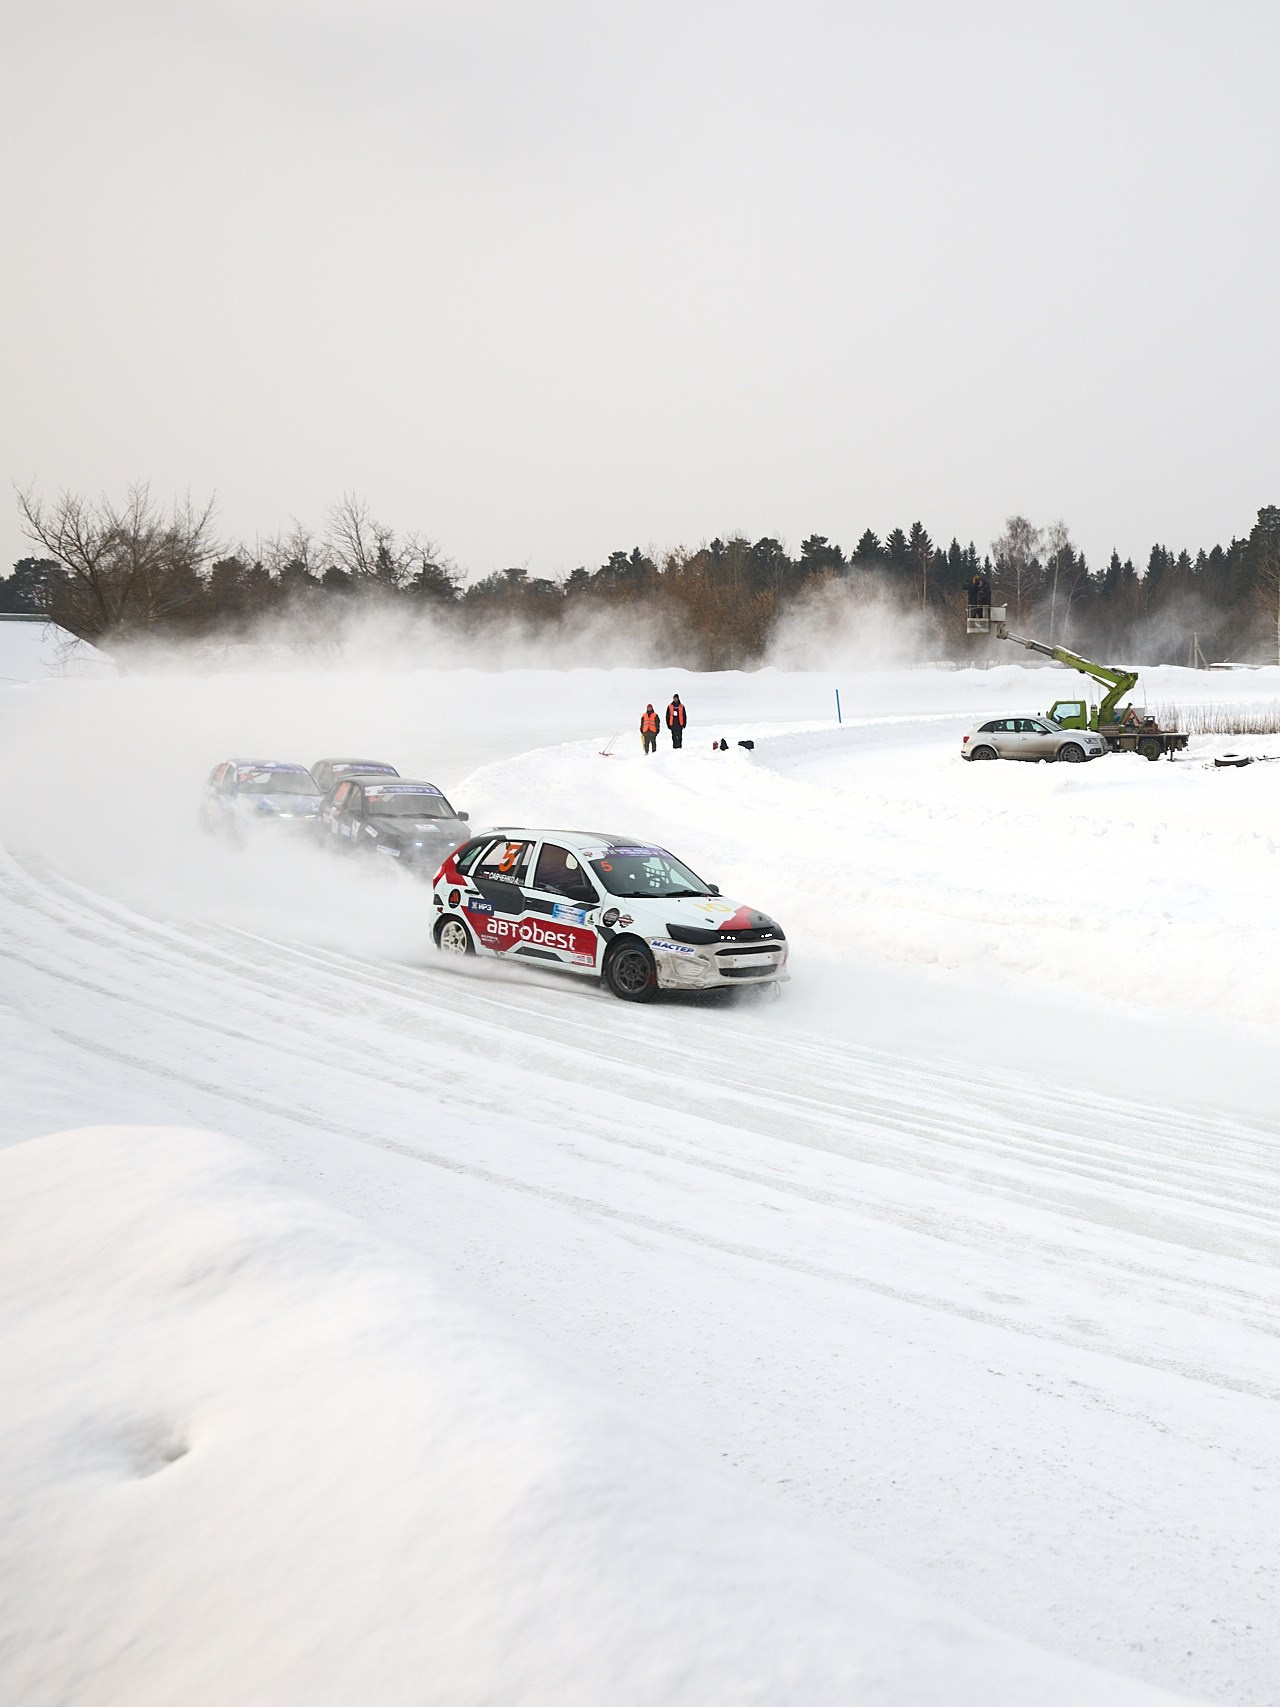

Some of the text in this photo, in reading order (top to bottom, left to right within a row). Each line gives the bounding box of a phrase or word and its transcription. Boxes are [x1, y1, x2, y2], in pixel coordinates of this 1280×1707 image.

[498, 841, 523, 873] 5
[600, 861, 613, 872] 5
[651, 940, 695, 953] МАСТЕР
